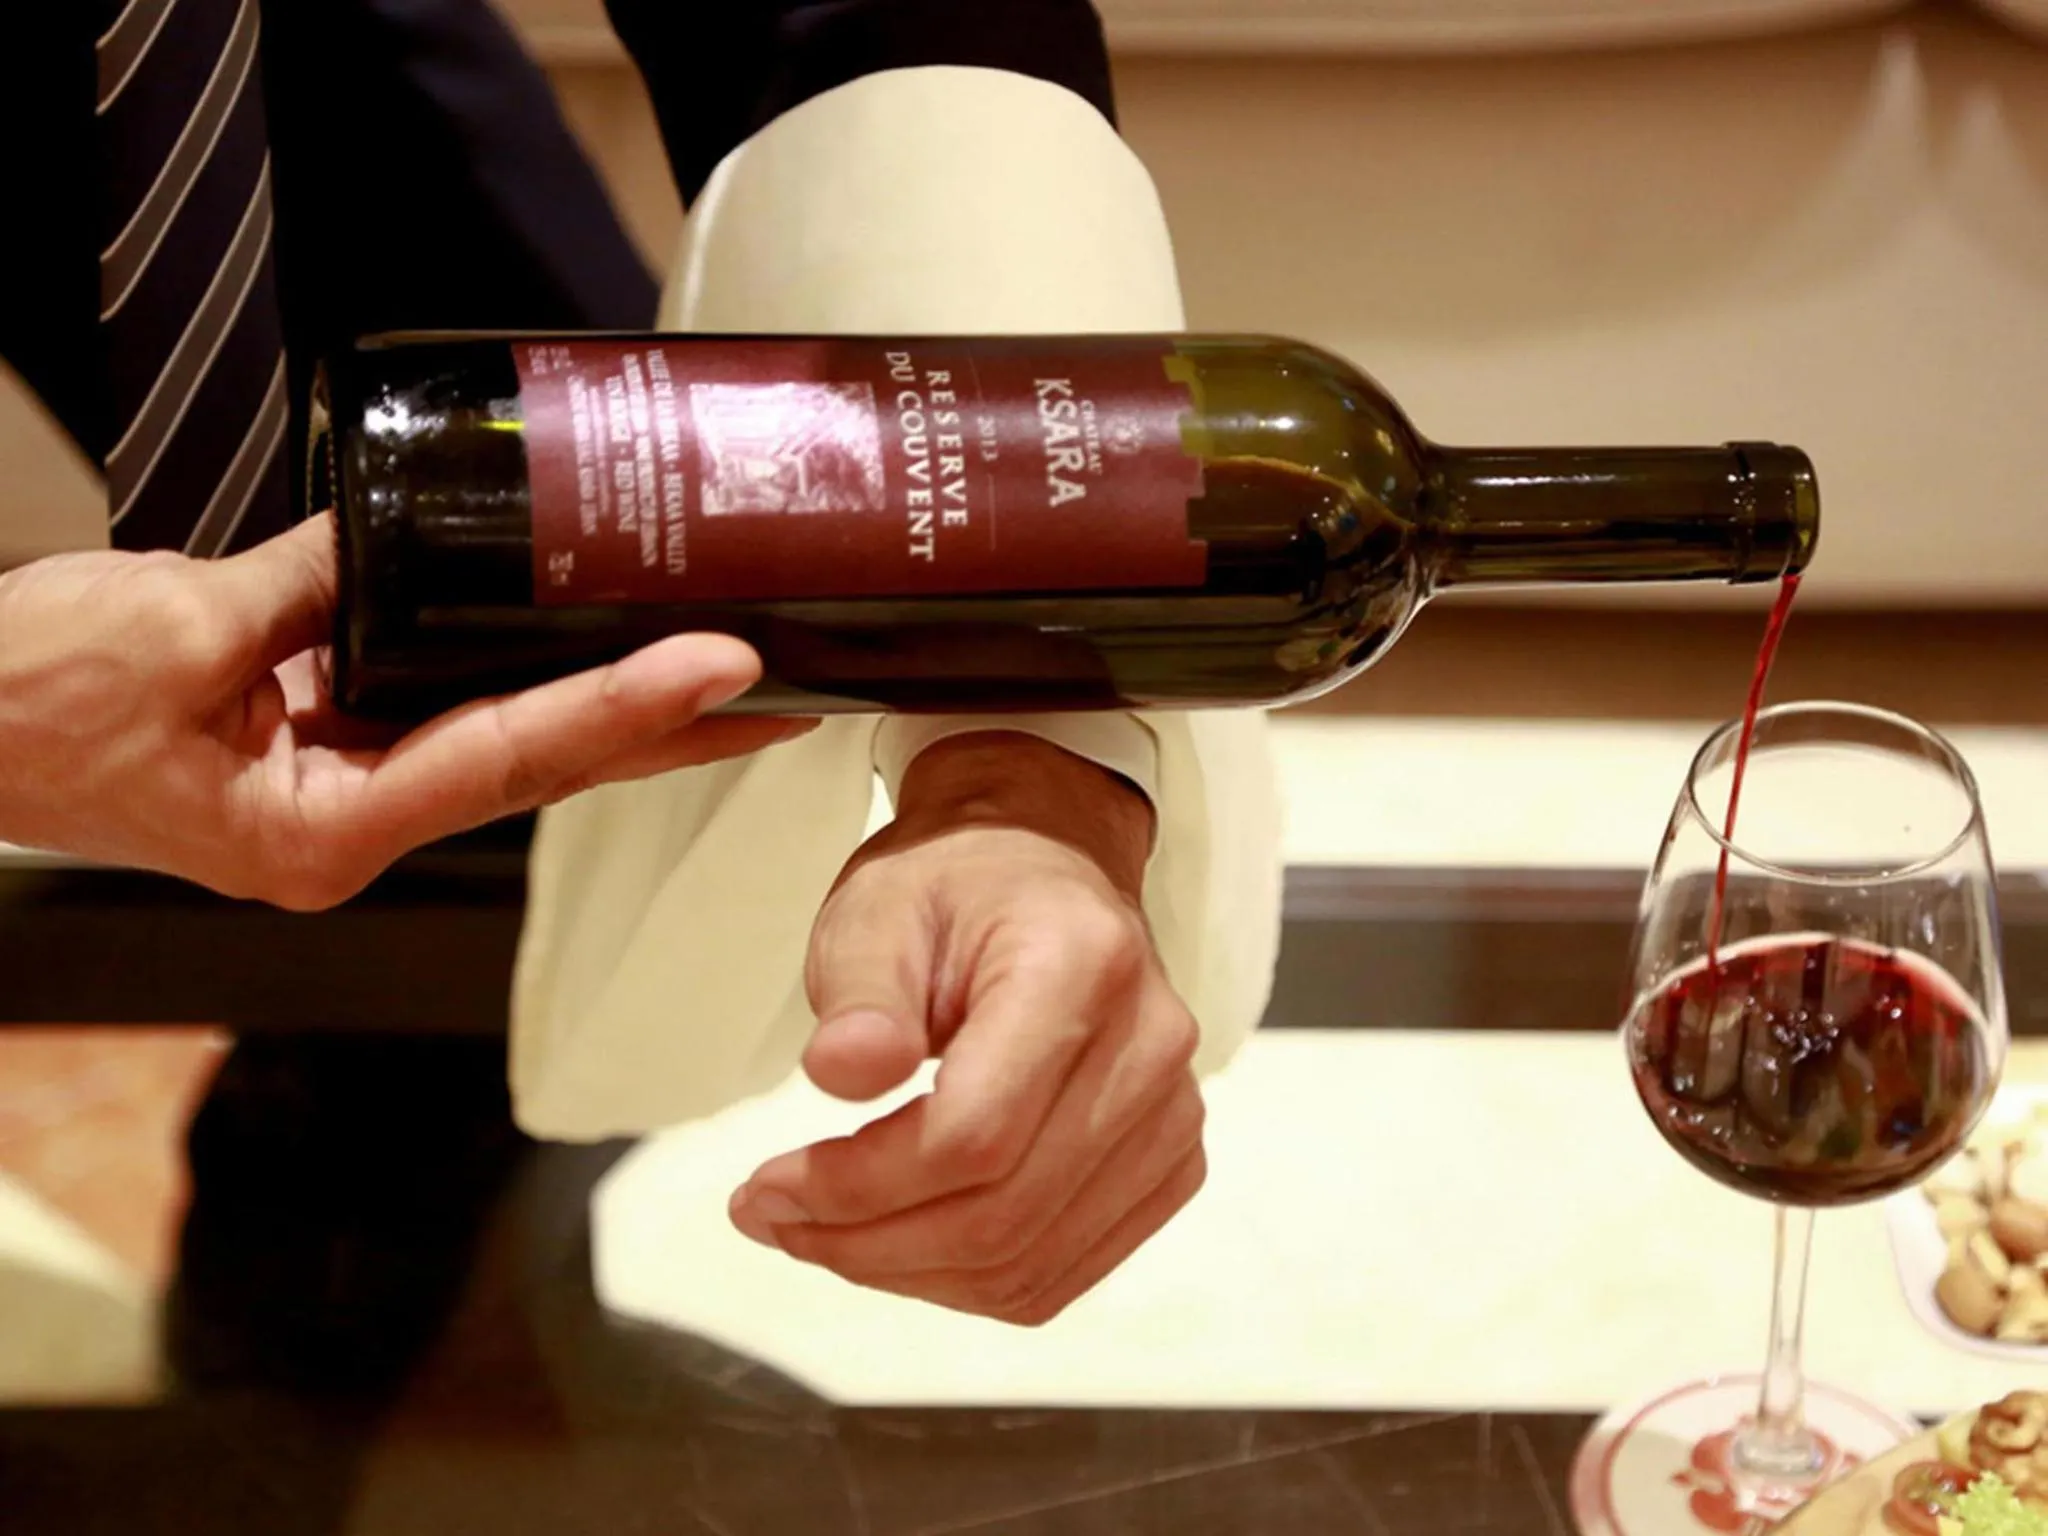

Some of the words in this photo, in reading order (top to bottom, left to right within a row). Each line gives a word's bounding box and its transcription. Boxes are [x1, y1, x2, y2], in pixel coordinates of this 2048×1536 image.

[886, 352, 916, 382] DU
[897, 390, 935, 562] COUVENT
[926, 370, 968, 526] RESERVE
[978, 415, 998, 462] 2013
[1034, 379, 1087, 508] KSARA
[1081, 400, 1102, 475] CHATEAU
